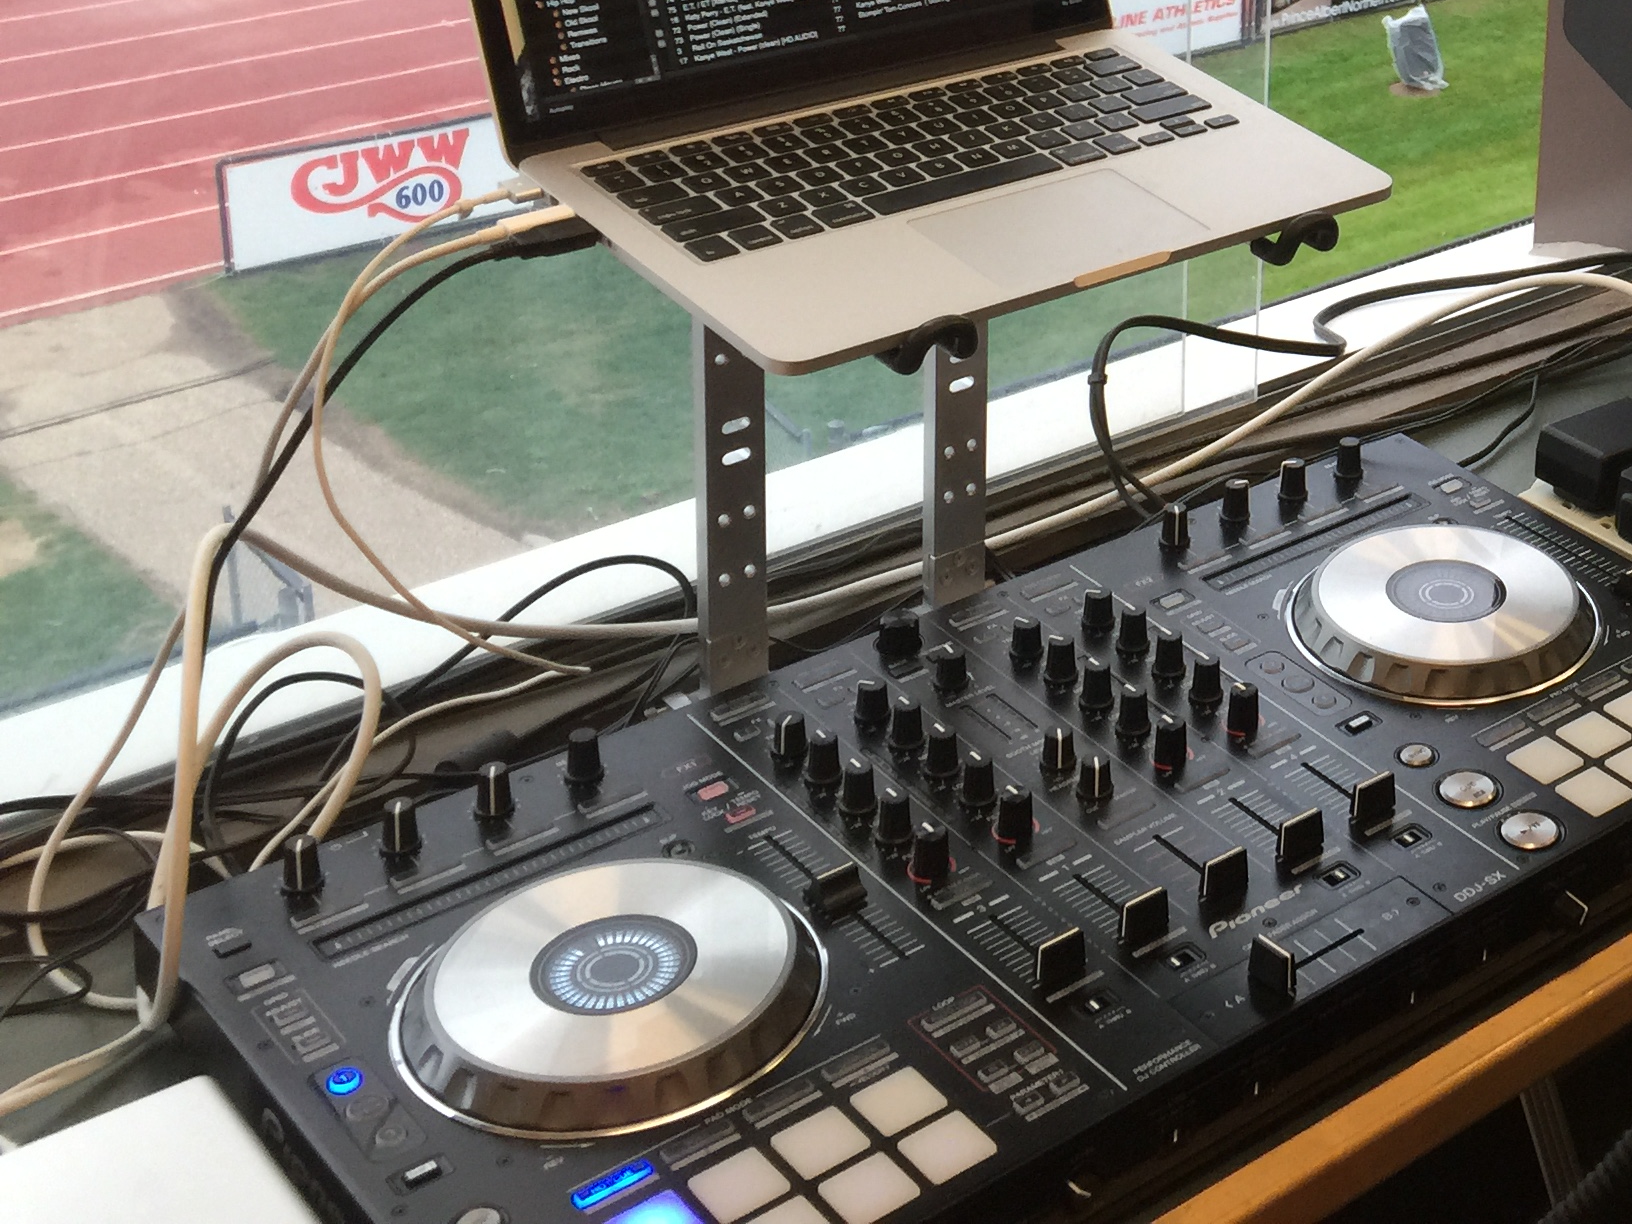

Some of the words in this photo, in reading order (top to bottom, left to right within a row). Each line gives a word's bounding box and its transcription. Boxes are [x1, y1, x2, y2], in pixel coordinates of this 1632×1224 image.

[290, 128, 470, 215] CJWW
[395, 179, 444, 209] 600
[1453, 870, 1508, 904] DDJ-SX
[1208, 883, 1303, 940] Pioneer
[1132, 1038, 1194, 1075] PERFORMANCE
[1149, 1042, 1202, 1076] CONTROLLER
[703, 1111, 725, 1127] PAD
[725, 1097, 754, 1115] MODE
